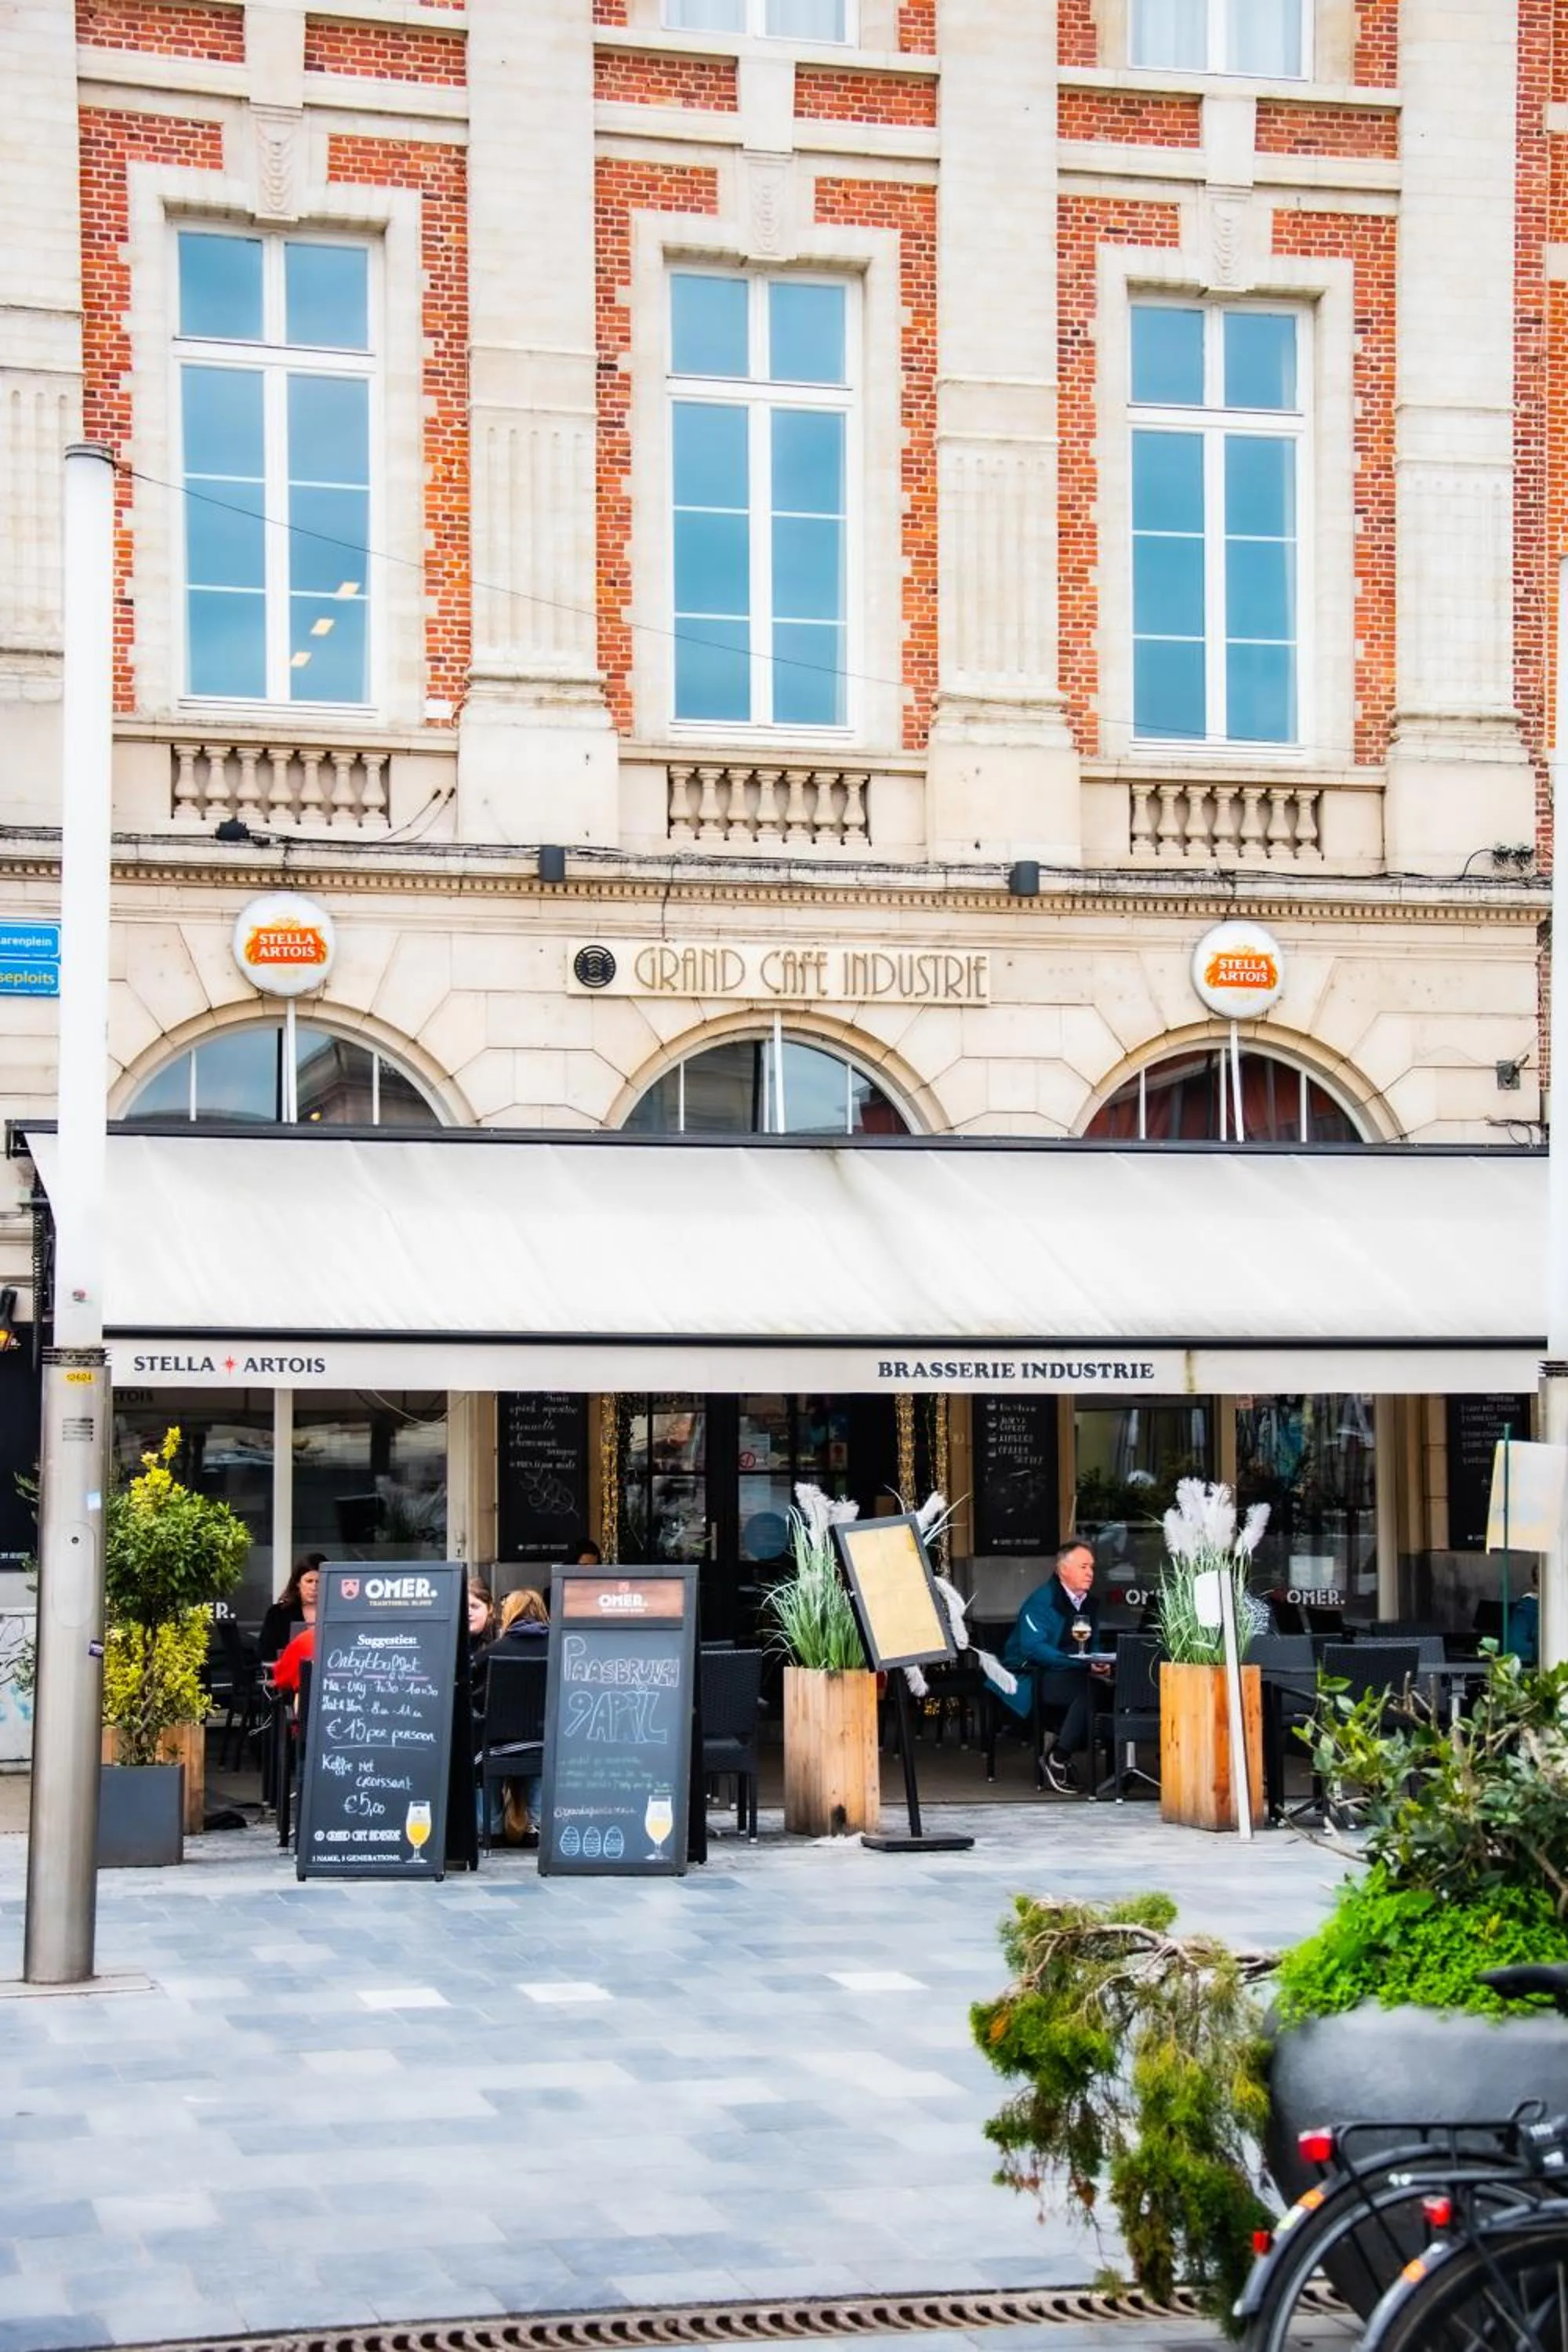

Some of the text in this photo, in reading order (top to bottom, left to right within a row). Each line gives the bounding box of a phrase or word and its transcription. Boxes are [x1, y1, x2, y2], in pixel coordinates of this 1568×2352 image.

[0, 935, 53, 948] arenplein
[259, 933, 314, 945] STELLA
[260, 946, 317, 957] ARTOIS
[1218, 958, 1268, 971] STELLA
[0, 971, 56, 987] seploits
[634, 946, 746, 993] GRAND
[844, 951, 988, 999] INDUSTRIE
[1218, 971, 1269, 982] ARTOIS
[133, 1355, 326, 1374] STELLA ARTOIS
[877, 1361, 1155, 1380] BRASSERIE INDUSTRIE
